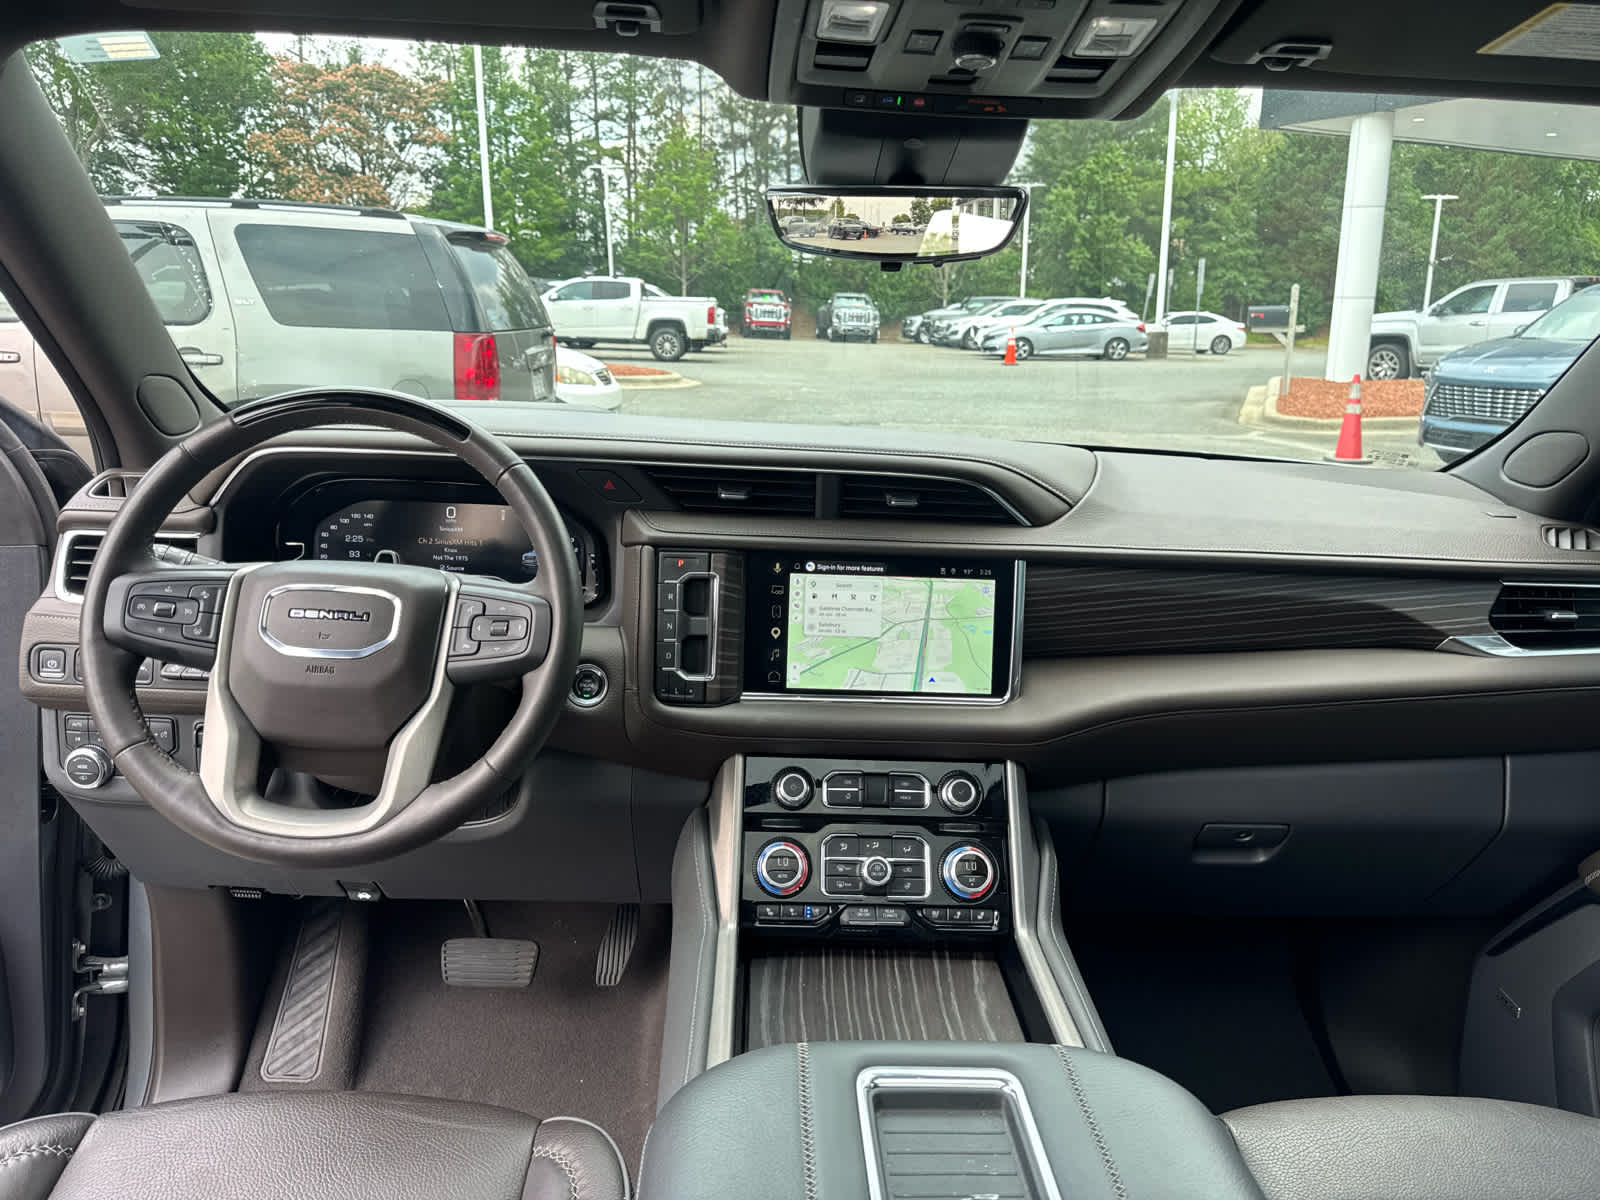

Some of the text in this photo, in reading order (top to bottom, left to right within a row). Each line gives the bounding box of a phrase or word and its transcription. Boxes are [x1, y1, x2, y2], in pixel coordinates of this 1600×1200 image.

[446, 506, 456, 519] 0
[288, 608, 370, 622] DENALI
[665, 652, 672, 660] D
[305, 664, 335, 674] AIRBAG
